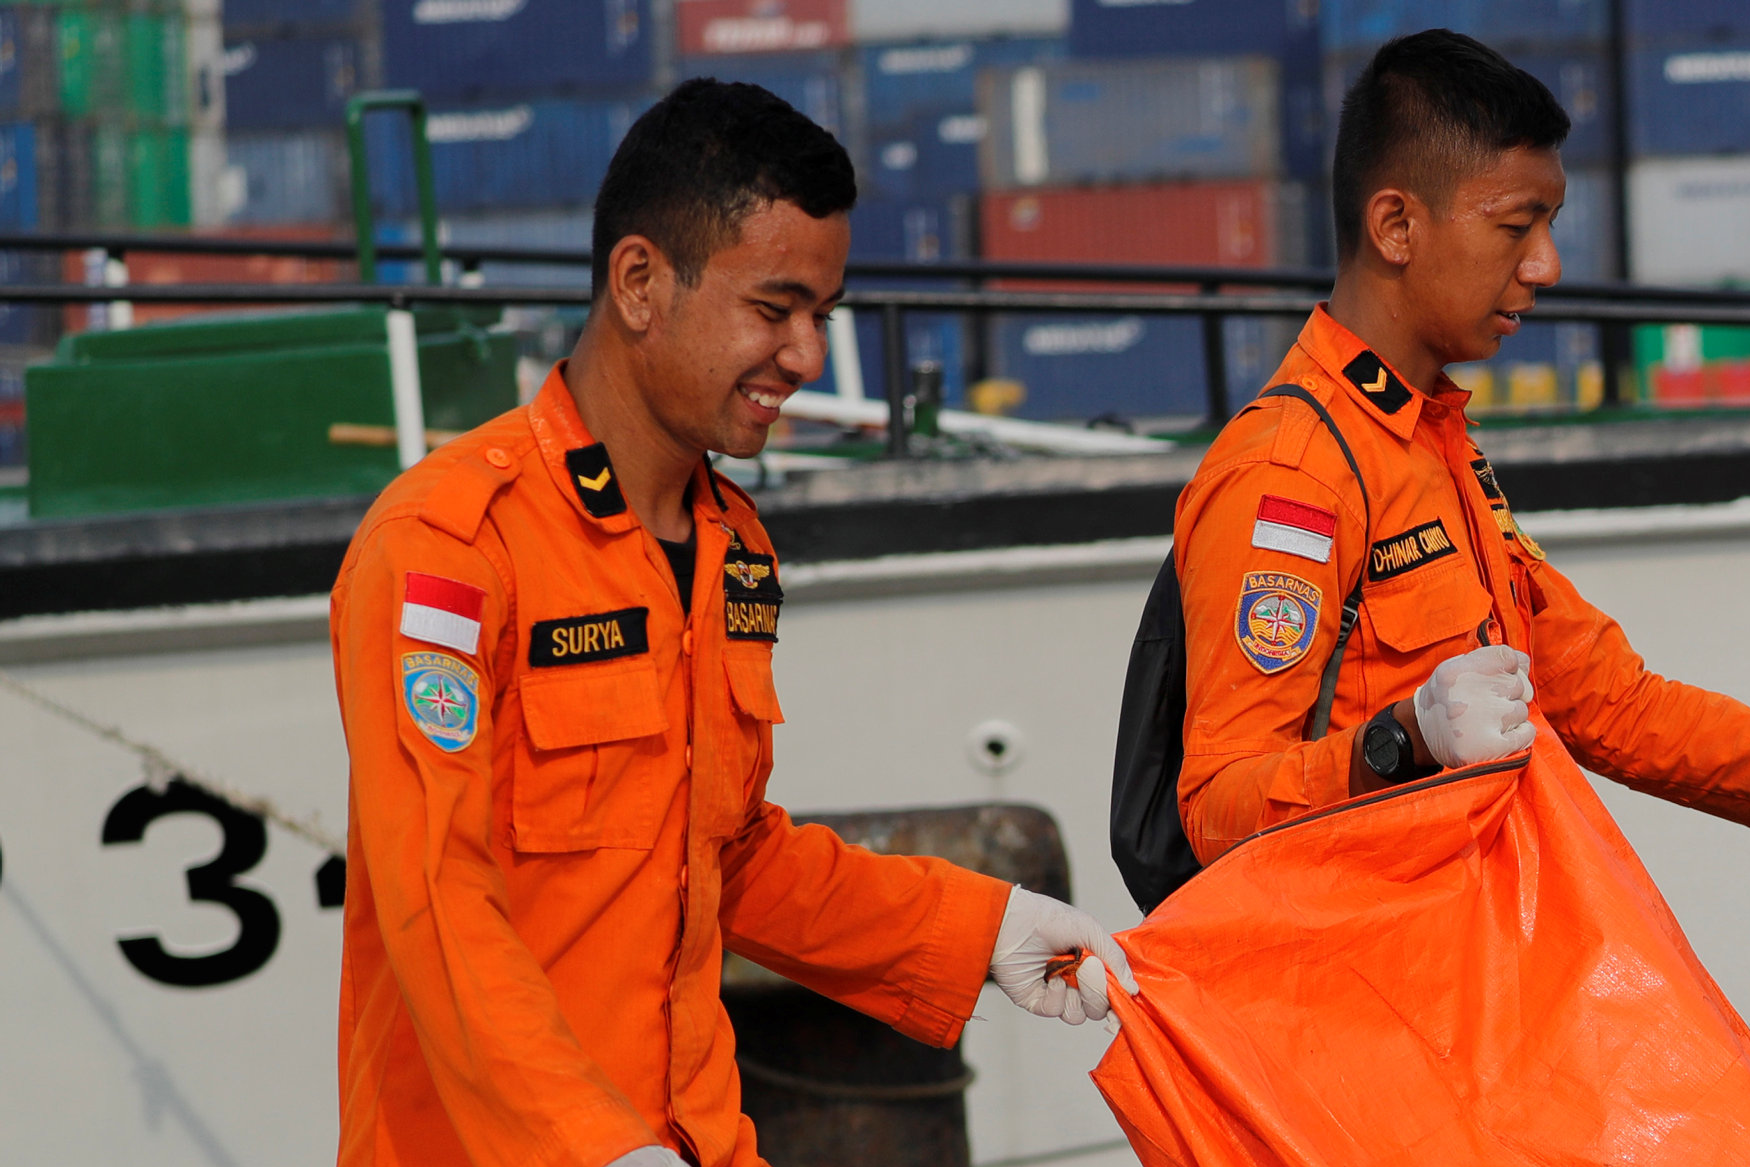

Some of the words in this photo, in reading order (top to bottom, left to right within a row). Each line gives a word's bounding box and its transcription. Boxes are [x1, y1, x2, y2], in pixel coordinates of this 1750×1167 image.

[1373, 536, 1423, 573] DHINAR
[1248, 575, 1320, 602] BASARNAS
[552, 620, 625, 658] SURYA
[405, 654, 477, 684] BASARNAS
